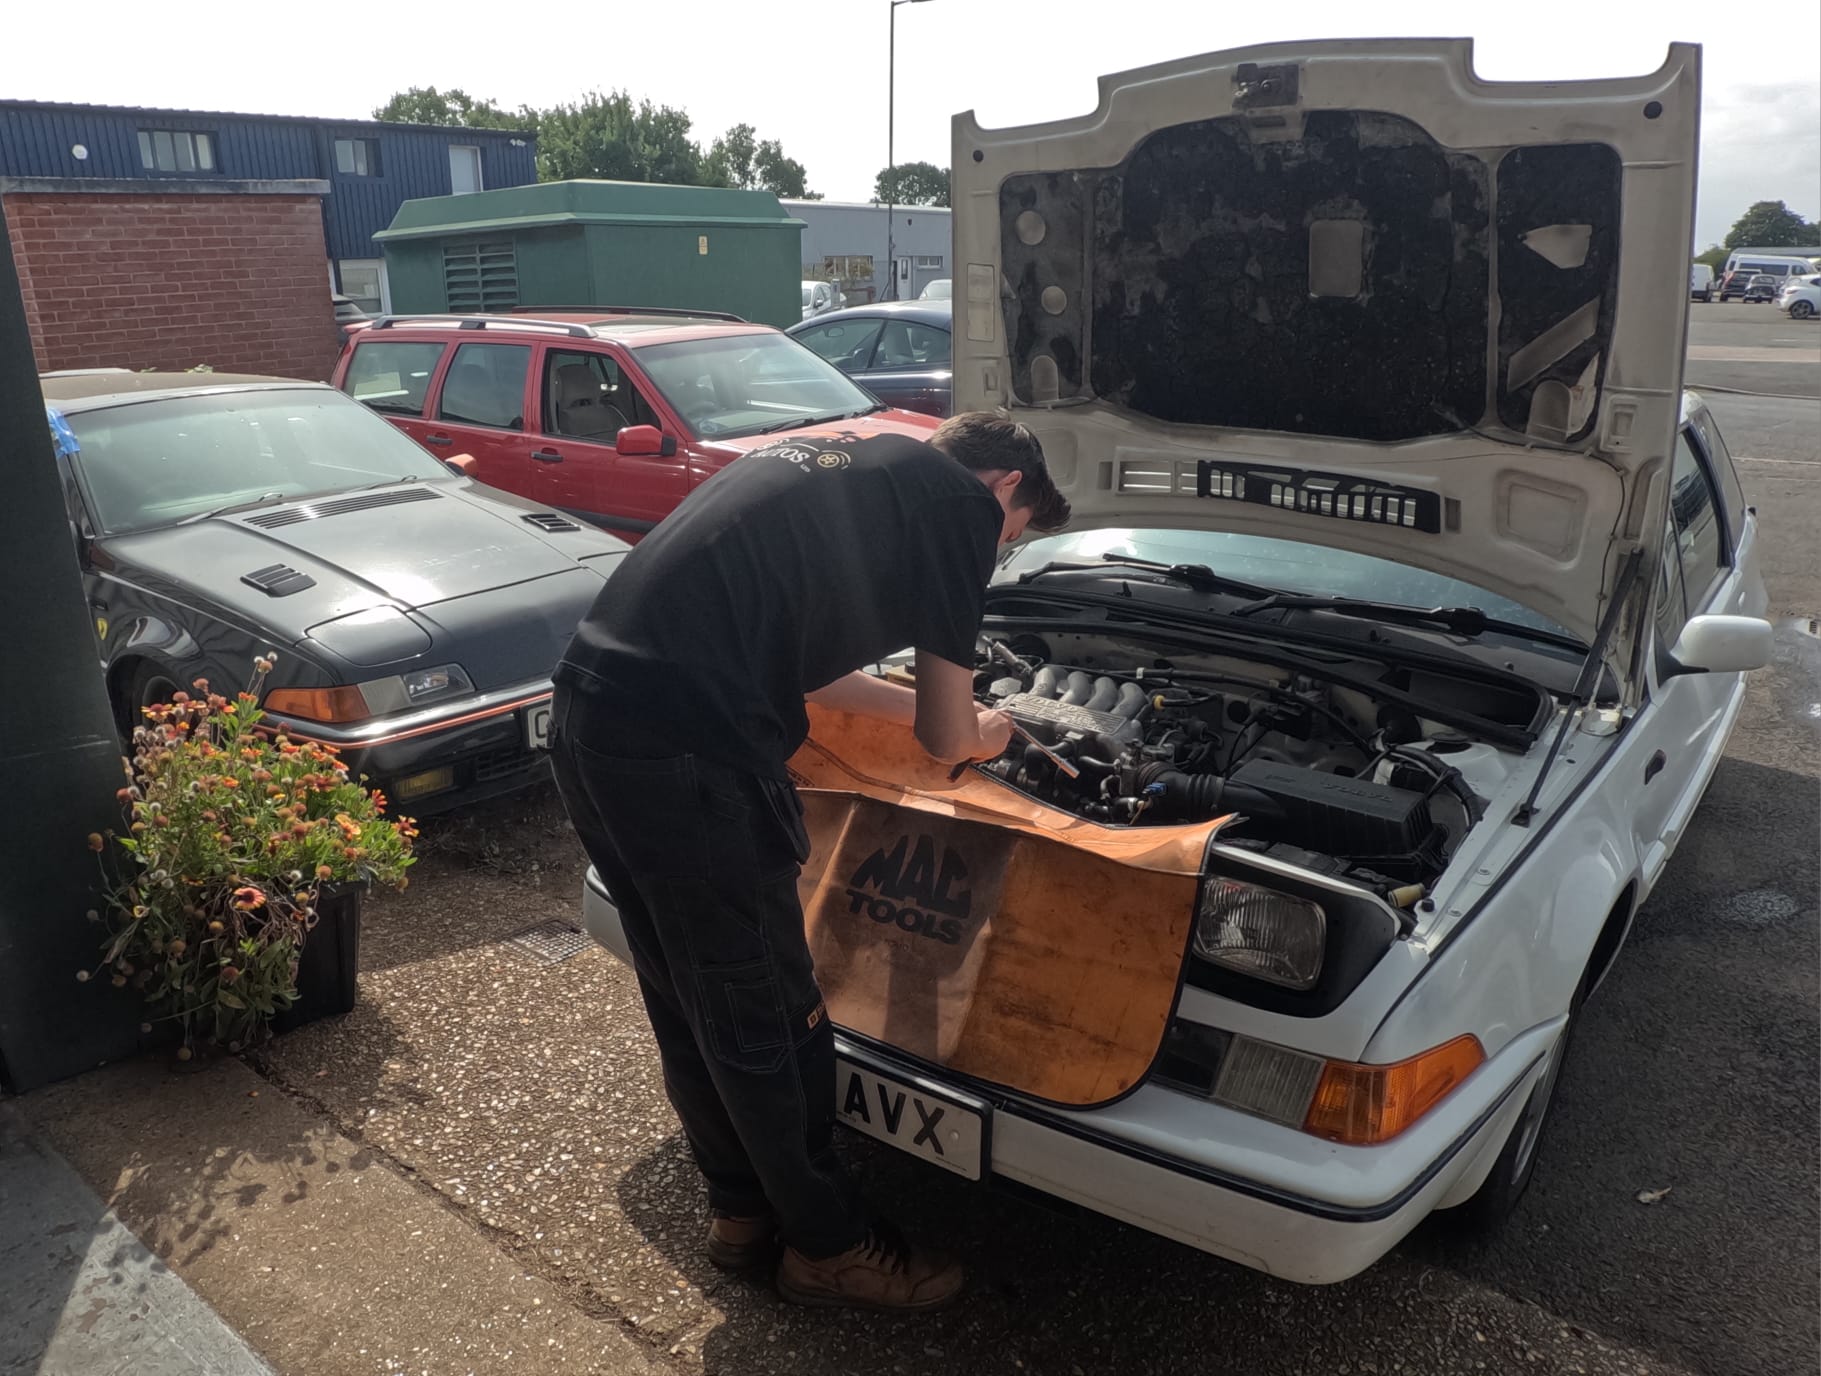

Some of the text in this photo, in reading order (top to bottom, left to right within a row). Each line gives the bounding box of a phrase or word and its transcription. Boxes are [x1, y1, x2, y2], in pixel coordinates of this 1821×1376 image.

[846, 888, 961, 945] TOOLS
[851, 834, 972, 919] MAC
[843, 1072, 945, 1156] AVX
